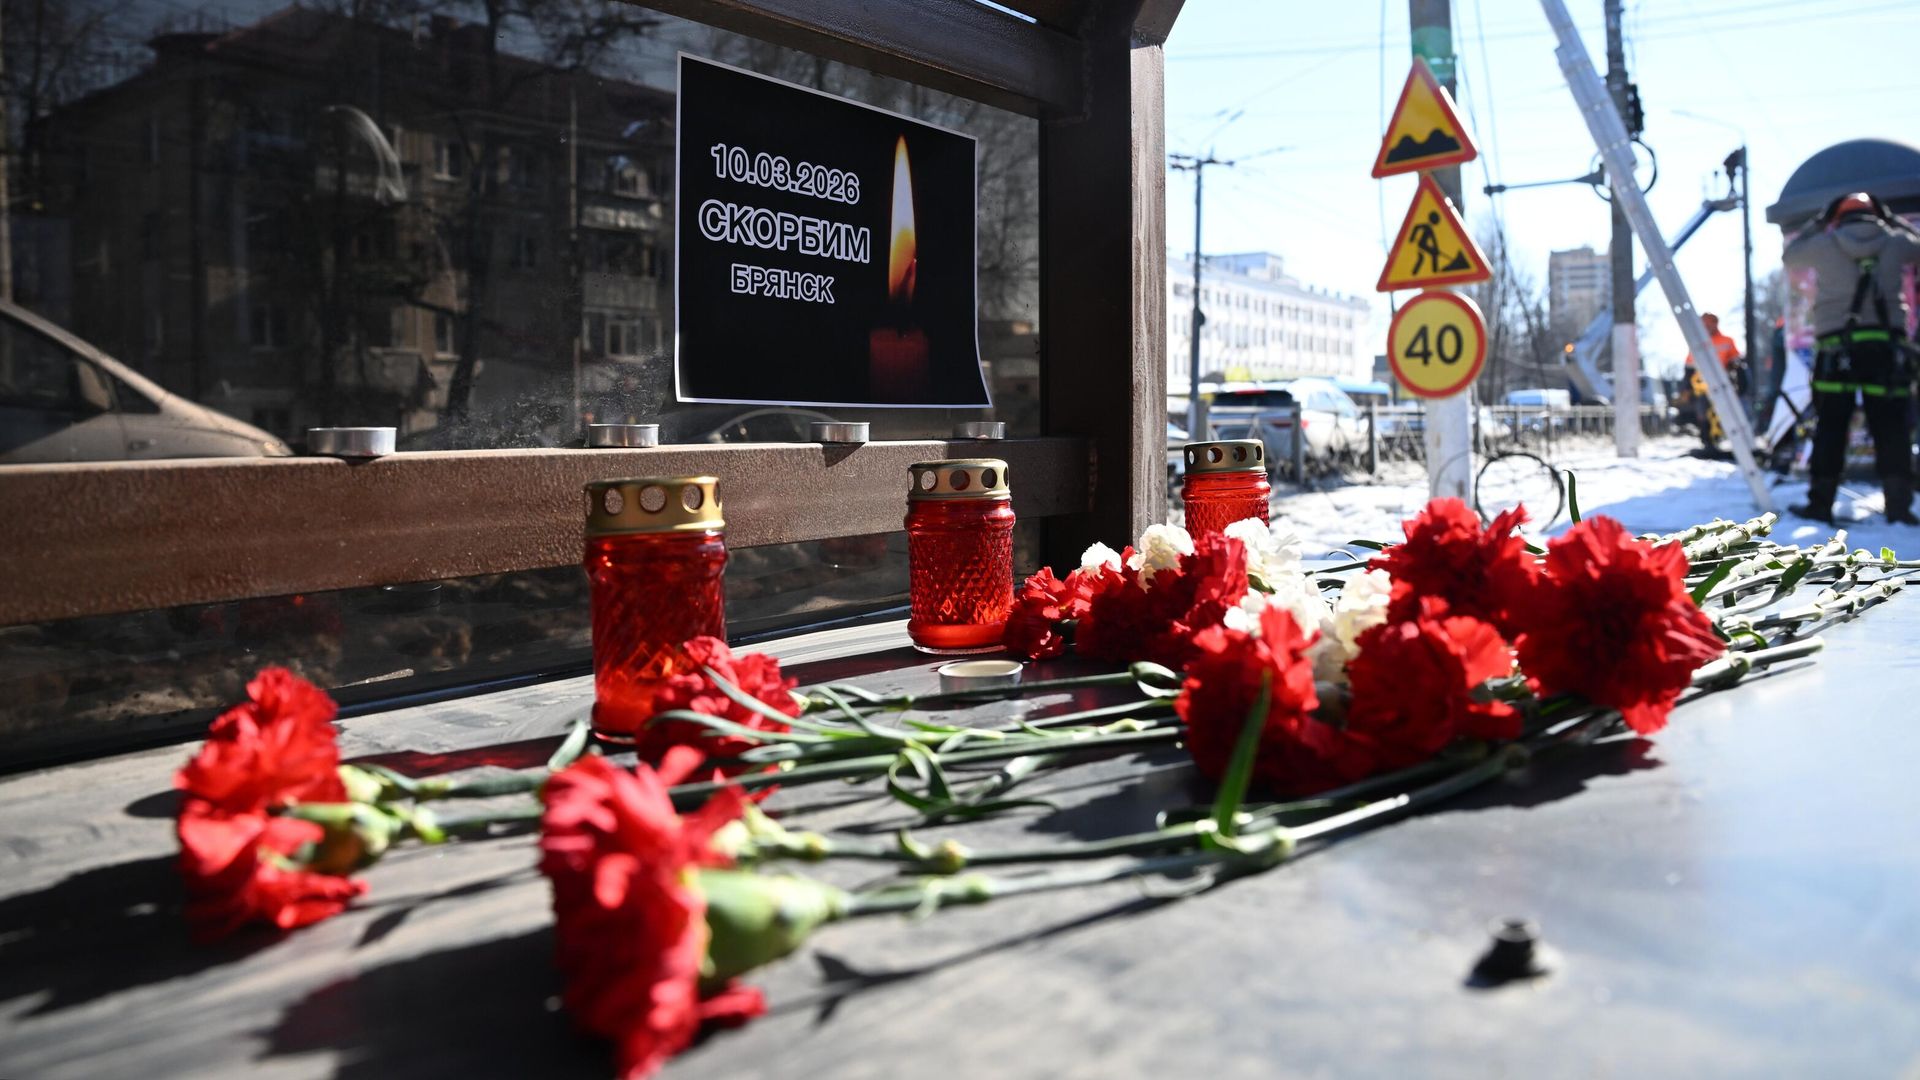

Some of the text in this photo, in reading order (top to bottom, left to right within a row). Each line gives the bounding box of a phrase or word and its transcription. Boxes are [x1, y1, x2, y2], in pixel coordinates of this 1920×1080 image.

[711, 144, 859, 204] 10.03.2026
[699, 199, 870, 263] СКОРБИМ
[732, 264, 835, 303] БРЯНСК
[1405, 324, 1463, 365] 40
